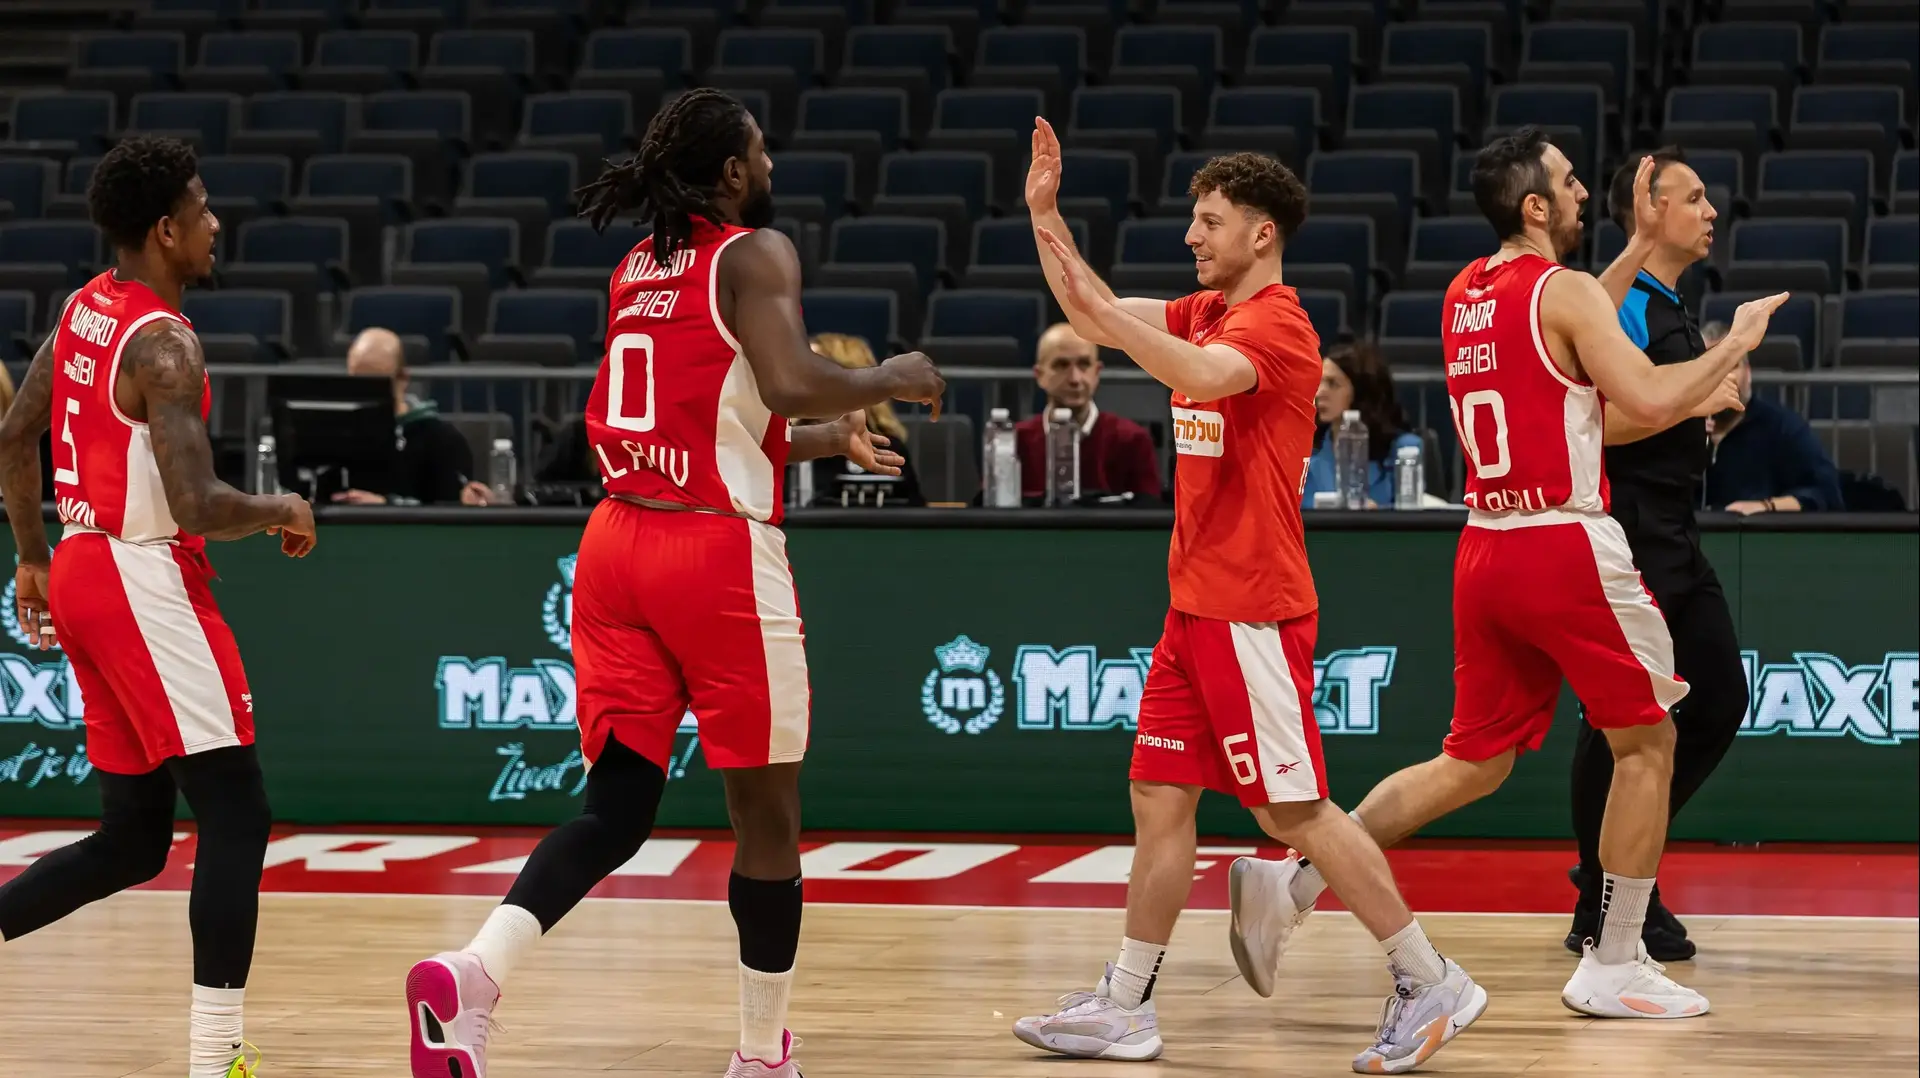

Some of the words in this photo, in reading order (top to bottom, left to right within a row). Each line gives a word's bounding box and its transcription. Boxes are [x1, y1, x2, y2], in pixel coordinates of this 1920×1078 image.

[643, 290, 680, 319] IBI
[1451, 299, 1497, 334] TIMOR
[1473, 342, 1498, 374] IBI
[606, 333, 656, 432] 0
[54, 397, 80, 486] 5
[1223, 732, 1258, 786] 6
